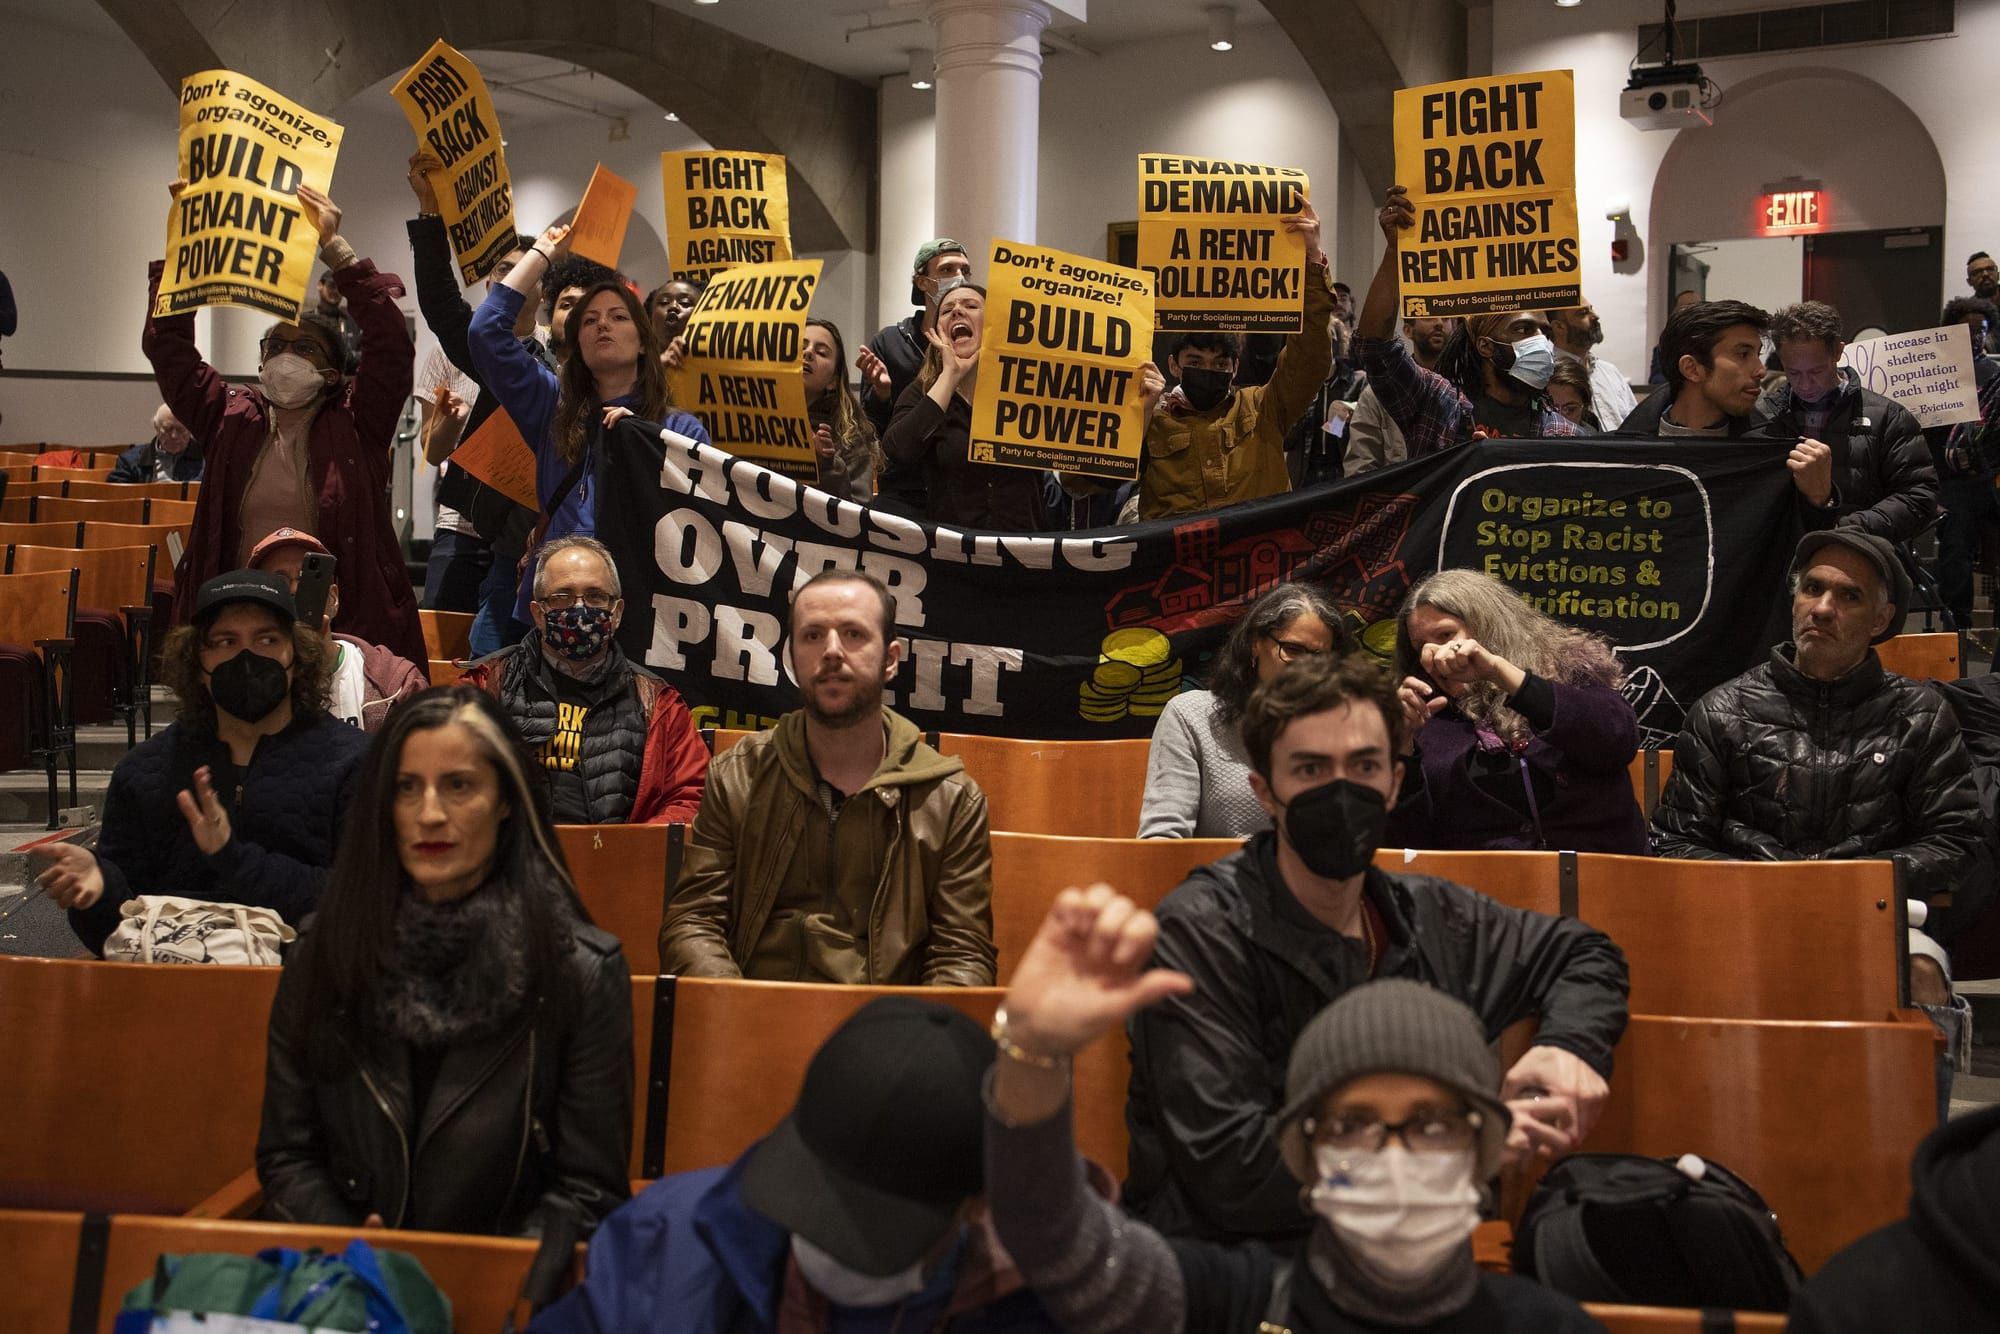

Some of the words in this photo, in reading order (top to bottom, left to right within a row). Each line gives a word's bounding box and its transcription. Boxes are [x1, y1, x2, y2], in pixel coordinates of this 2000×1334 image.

[406, 55, 469, 124] FIGHT
[182, 79, 230, 107] Don't
[234, 88, 332, 148] agonize,
[197, 105, 302, 150] organize!
[1422, 81, 1543, 139] FIGHT
[427, 96, 490, 169] BACK
[189, 134, 303, 195] BUILD
[454, 150, 498, 213] AGAINST
[684, 156, 766, 191] FIGHT
[1140, 157, 1304, 177] TENANTS
[1424, 138, 1545, 194] BACK
[686, 196, 770, 231] BACK
[1145, 180, 1303, 215] DEMAND
[1772, 192, 1814, 225] EXIT
[180, 191, 300, 243] TENANT
[449, 206, 483, 255] RENT
[477, 182, 510, 234] HIKES
[1420, 199, 1553, 243] AGAINST
[175, 237, 285, 286] POWER
[686, 239, 776, 266] AGAINST
[1170, 228, 1191, 260] A
[1200, 228, 1275, 261] RENT
[1401, 246, 1478, 283] RENT
[1486, 238, 1578, 278] HIKES
[993, 247, 1055, 273] Don't
[1059, 262, 1149, 296] agonize,
[695, 273, 814, 314] TENANTS
[1021, 276, 1123, 306] organize!
[1433, 298, 1455, 307] Party
[1457, 297, 1469, 305] for
[1471, 294, 1513, 304] Socialism
[1534, 289, 1577, 299] Liberation
[1168, 313, 1188, 322] Party
[1190, 313, 1201, 321] for
[1203, 313, 1241, 322] Socialism
[1242, 314, 1257, 322] and
[1259, 314, 1299, 322] Liberation
[1406, 304, 1430, 316] PSL
[1007, 299, 1132, 358] BUILD
[1884, 336, 1931, 351] incease
[1935, 332, 1948, 343] in
[1887, 351, 1936, 367] shelters
[1890, 365, 1958, 386] population
[699, 373, 716, 405] A
[719, 374, 778, 410] RENT
[998, 355, 1133, 406] TENANT
[1893, 387, 1922, 399] each
[1927, 379, 1960, 394] night
[995, 399, 1121, 450] POWER
[1920, 400, 1964, 414] Evictions
[694, 410, 810, 449] OLLBACK!
[974, 447, 996, 462] PSL
[1000, 446, 1022, 458] Party
[1023, 449, 1034, 457] for
[1036, 450, 1075, 463] Socialism
[1077, 455, 1092, 464] and
[1094, 456, 1134, 469] Liberation
[659, 428, 1138, 572] HOUSING
[1481, 488, 1628, 521] Organize
[1637, 496, 1672, 520] to
[1476, 520, 1551, 554] Stop
[1563, 524, 1663, 552] Racist
[1484, 554, 1626, 585] Evictions
[1636, 560, 1661, 586] &
[1521, 589, 1680, 620] trification
[645, 593, 1023, 716] PRIT
[558, 702, 588, 731] RK
